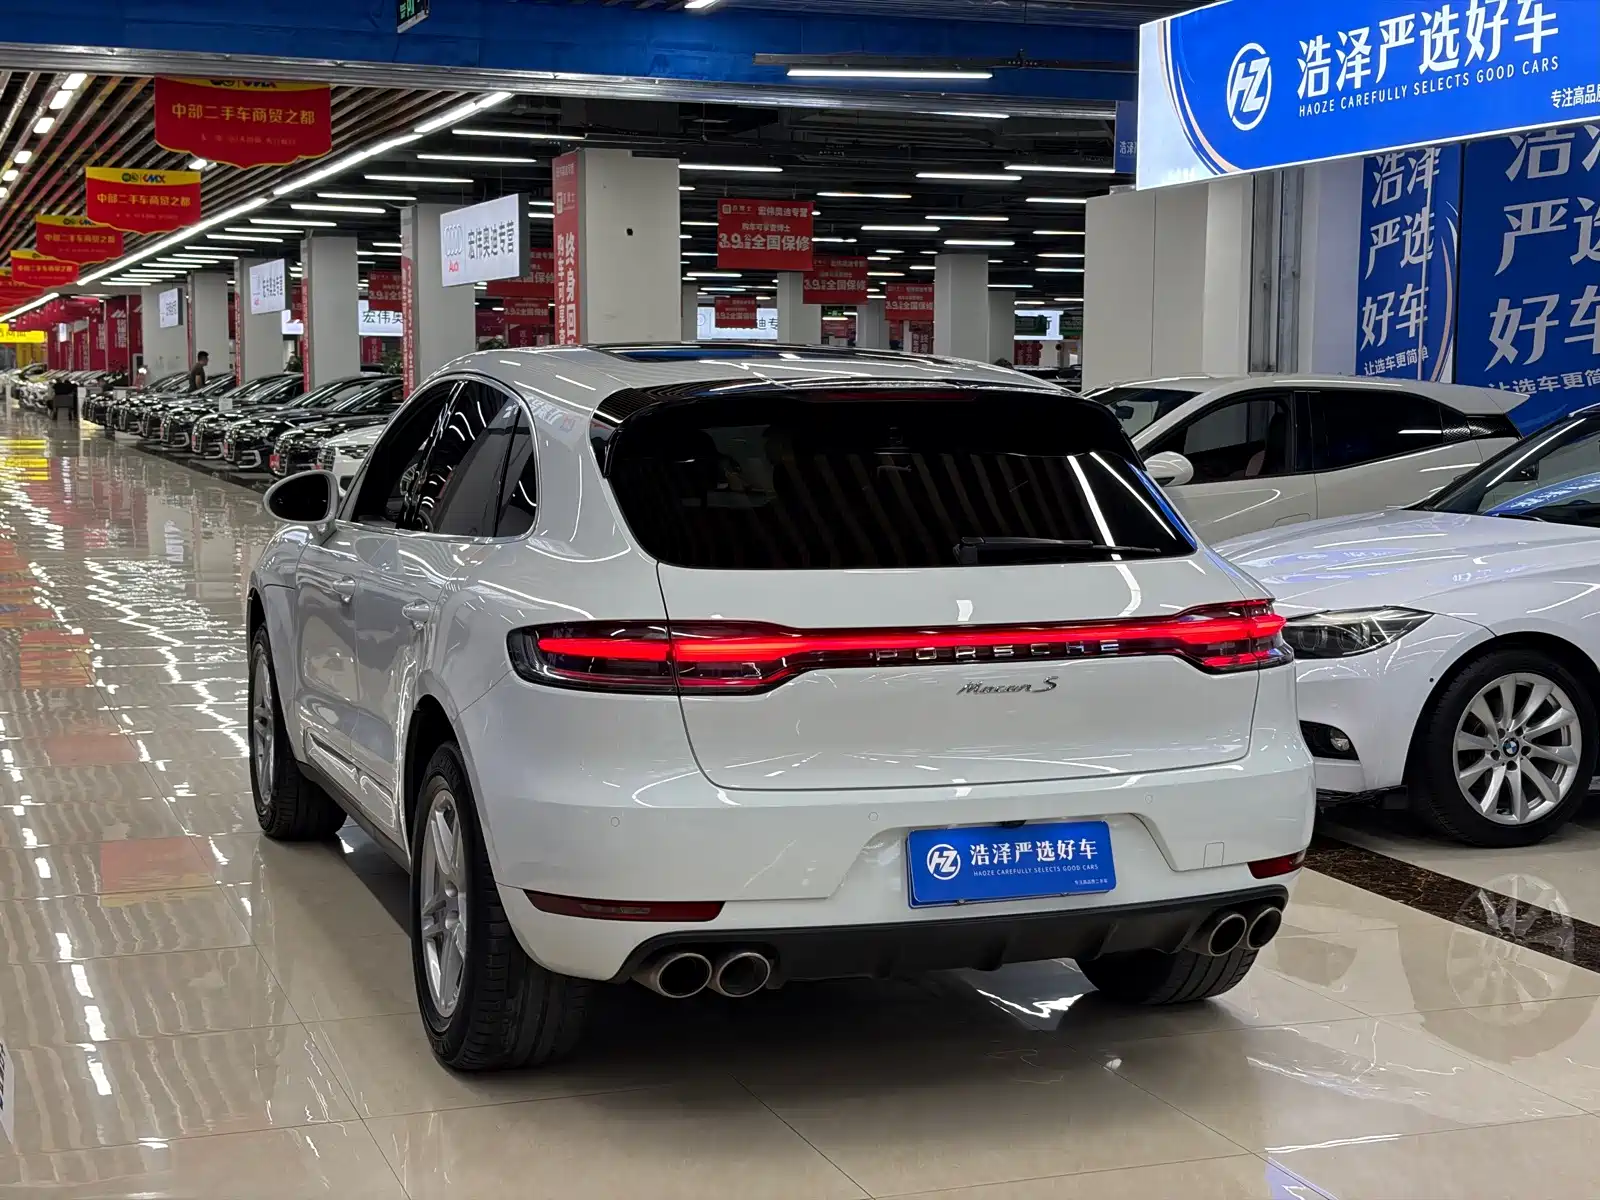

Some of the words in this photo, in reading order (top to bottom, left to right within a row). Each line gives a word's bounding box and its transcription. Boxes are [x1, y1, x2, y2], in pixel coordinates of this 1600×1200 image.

[1297, 0, 1559, 99] 浩泽严选好车
[1298, 99, 1335, 117] HAOZE
[1340, 85, 1408, 109] CAREFULLY
[1413, 72, 1469, 95] SELECTS
[1476, 63, 1515, 82] GOOD
[1522, 55, 1559, 75] CARS
[171, 103, 315, 125] 中部二手车商贸之都
[1120, 141, 1137, 155] 浩泽
[1364, 206, 1435, 281] 严选
[565, 231, 576, 345] 终身回
[1359, 283, 1430, 352] 好车
[876, 639, 1120, 661] PORSCHE
[956, 680, 1032, 696] Macan
[1031, 675, 1059, 693] S
[969, 838, 1099, 866] 浩泽严选好车
[973, 869, 995, 877] HAOZE
[996, 868, 1032, 876] CAREFULLY
[1034, 866, 1061, 874] SELECTS
[1082, 863, 1099, 871] CARS
